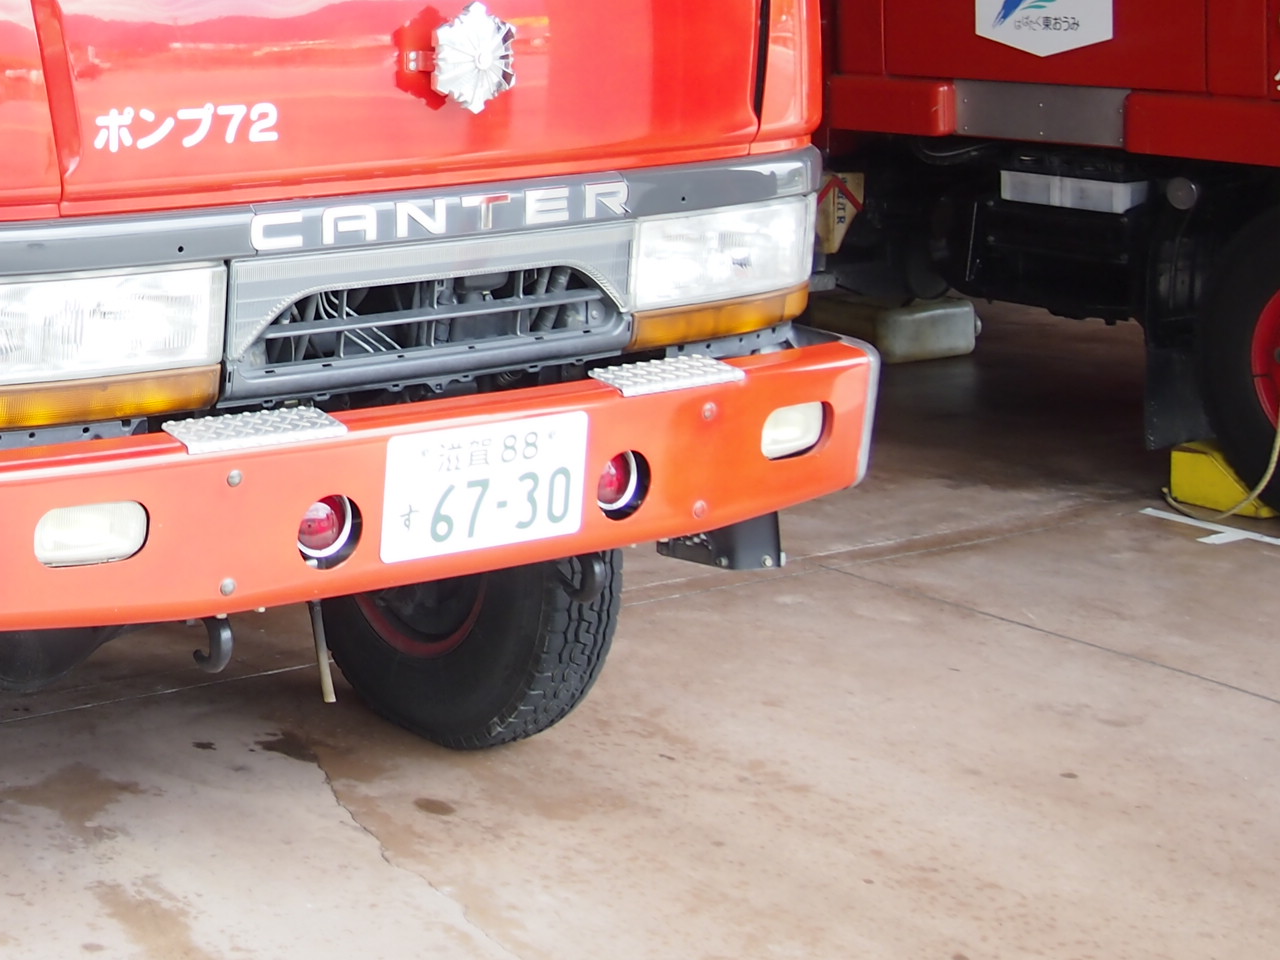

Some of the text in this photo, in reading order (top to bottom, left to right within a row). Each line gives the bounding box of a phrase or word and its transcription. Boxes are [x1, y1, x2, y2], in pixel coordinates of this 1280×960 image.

[93, 102, 279, 152] ポンプ72
[250, 181, 632, 252] CANTER
[430, 466, 572, 543] 67-30
